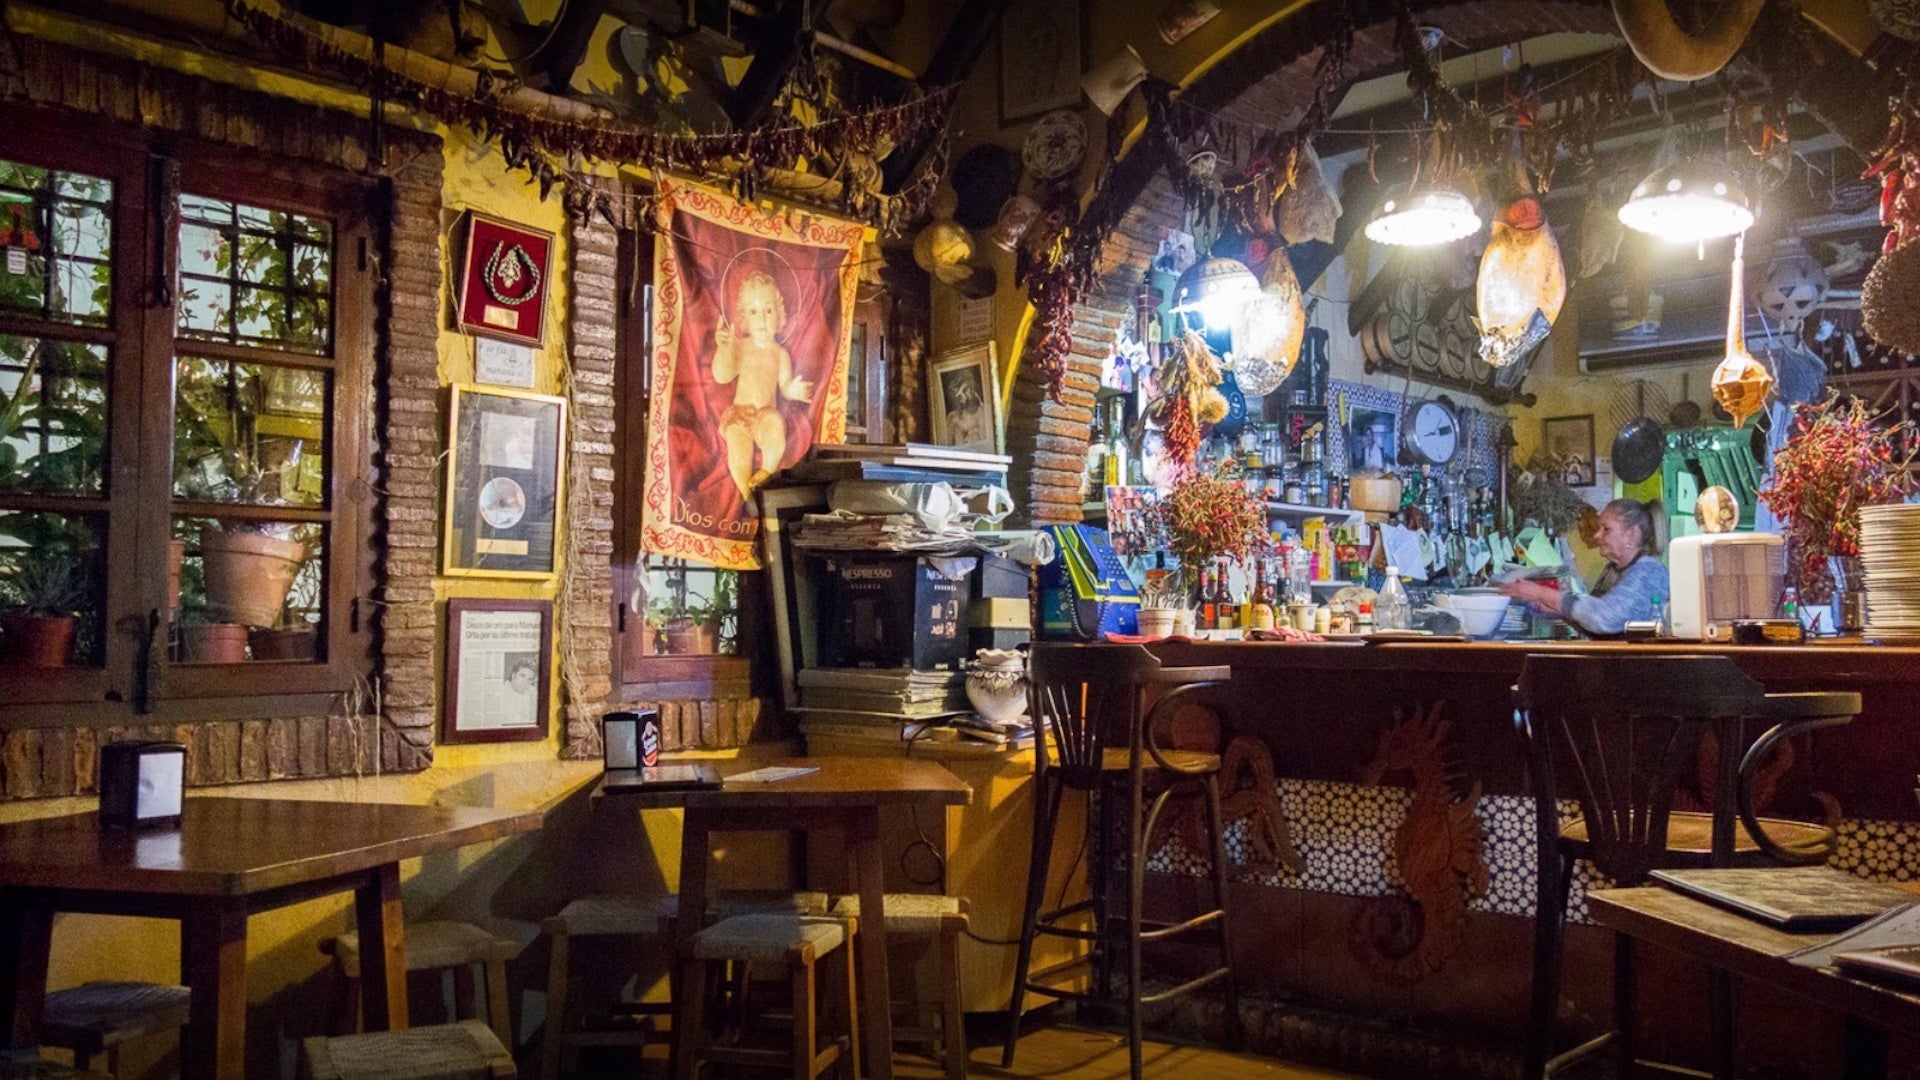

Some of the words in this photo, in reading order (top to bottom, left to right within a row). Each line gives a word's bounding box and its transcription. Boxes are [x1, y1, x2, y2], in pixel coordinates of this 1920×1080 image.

[673, 495, 713, 528] Dios
[718, 519, 750, 534] con
[841, 568, 892, 581] NESPRESSO
